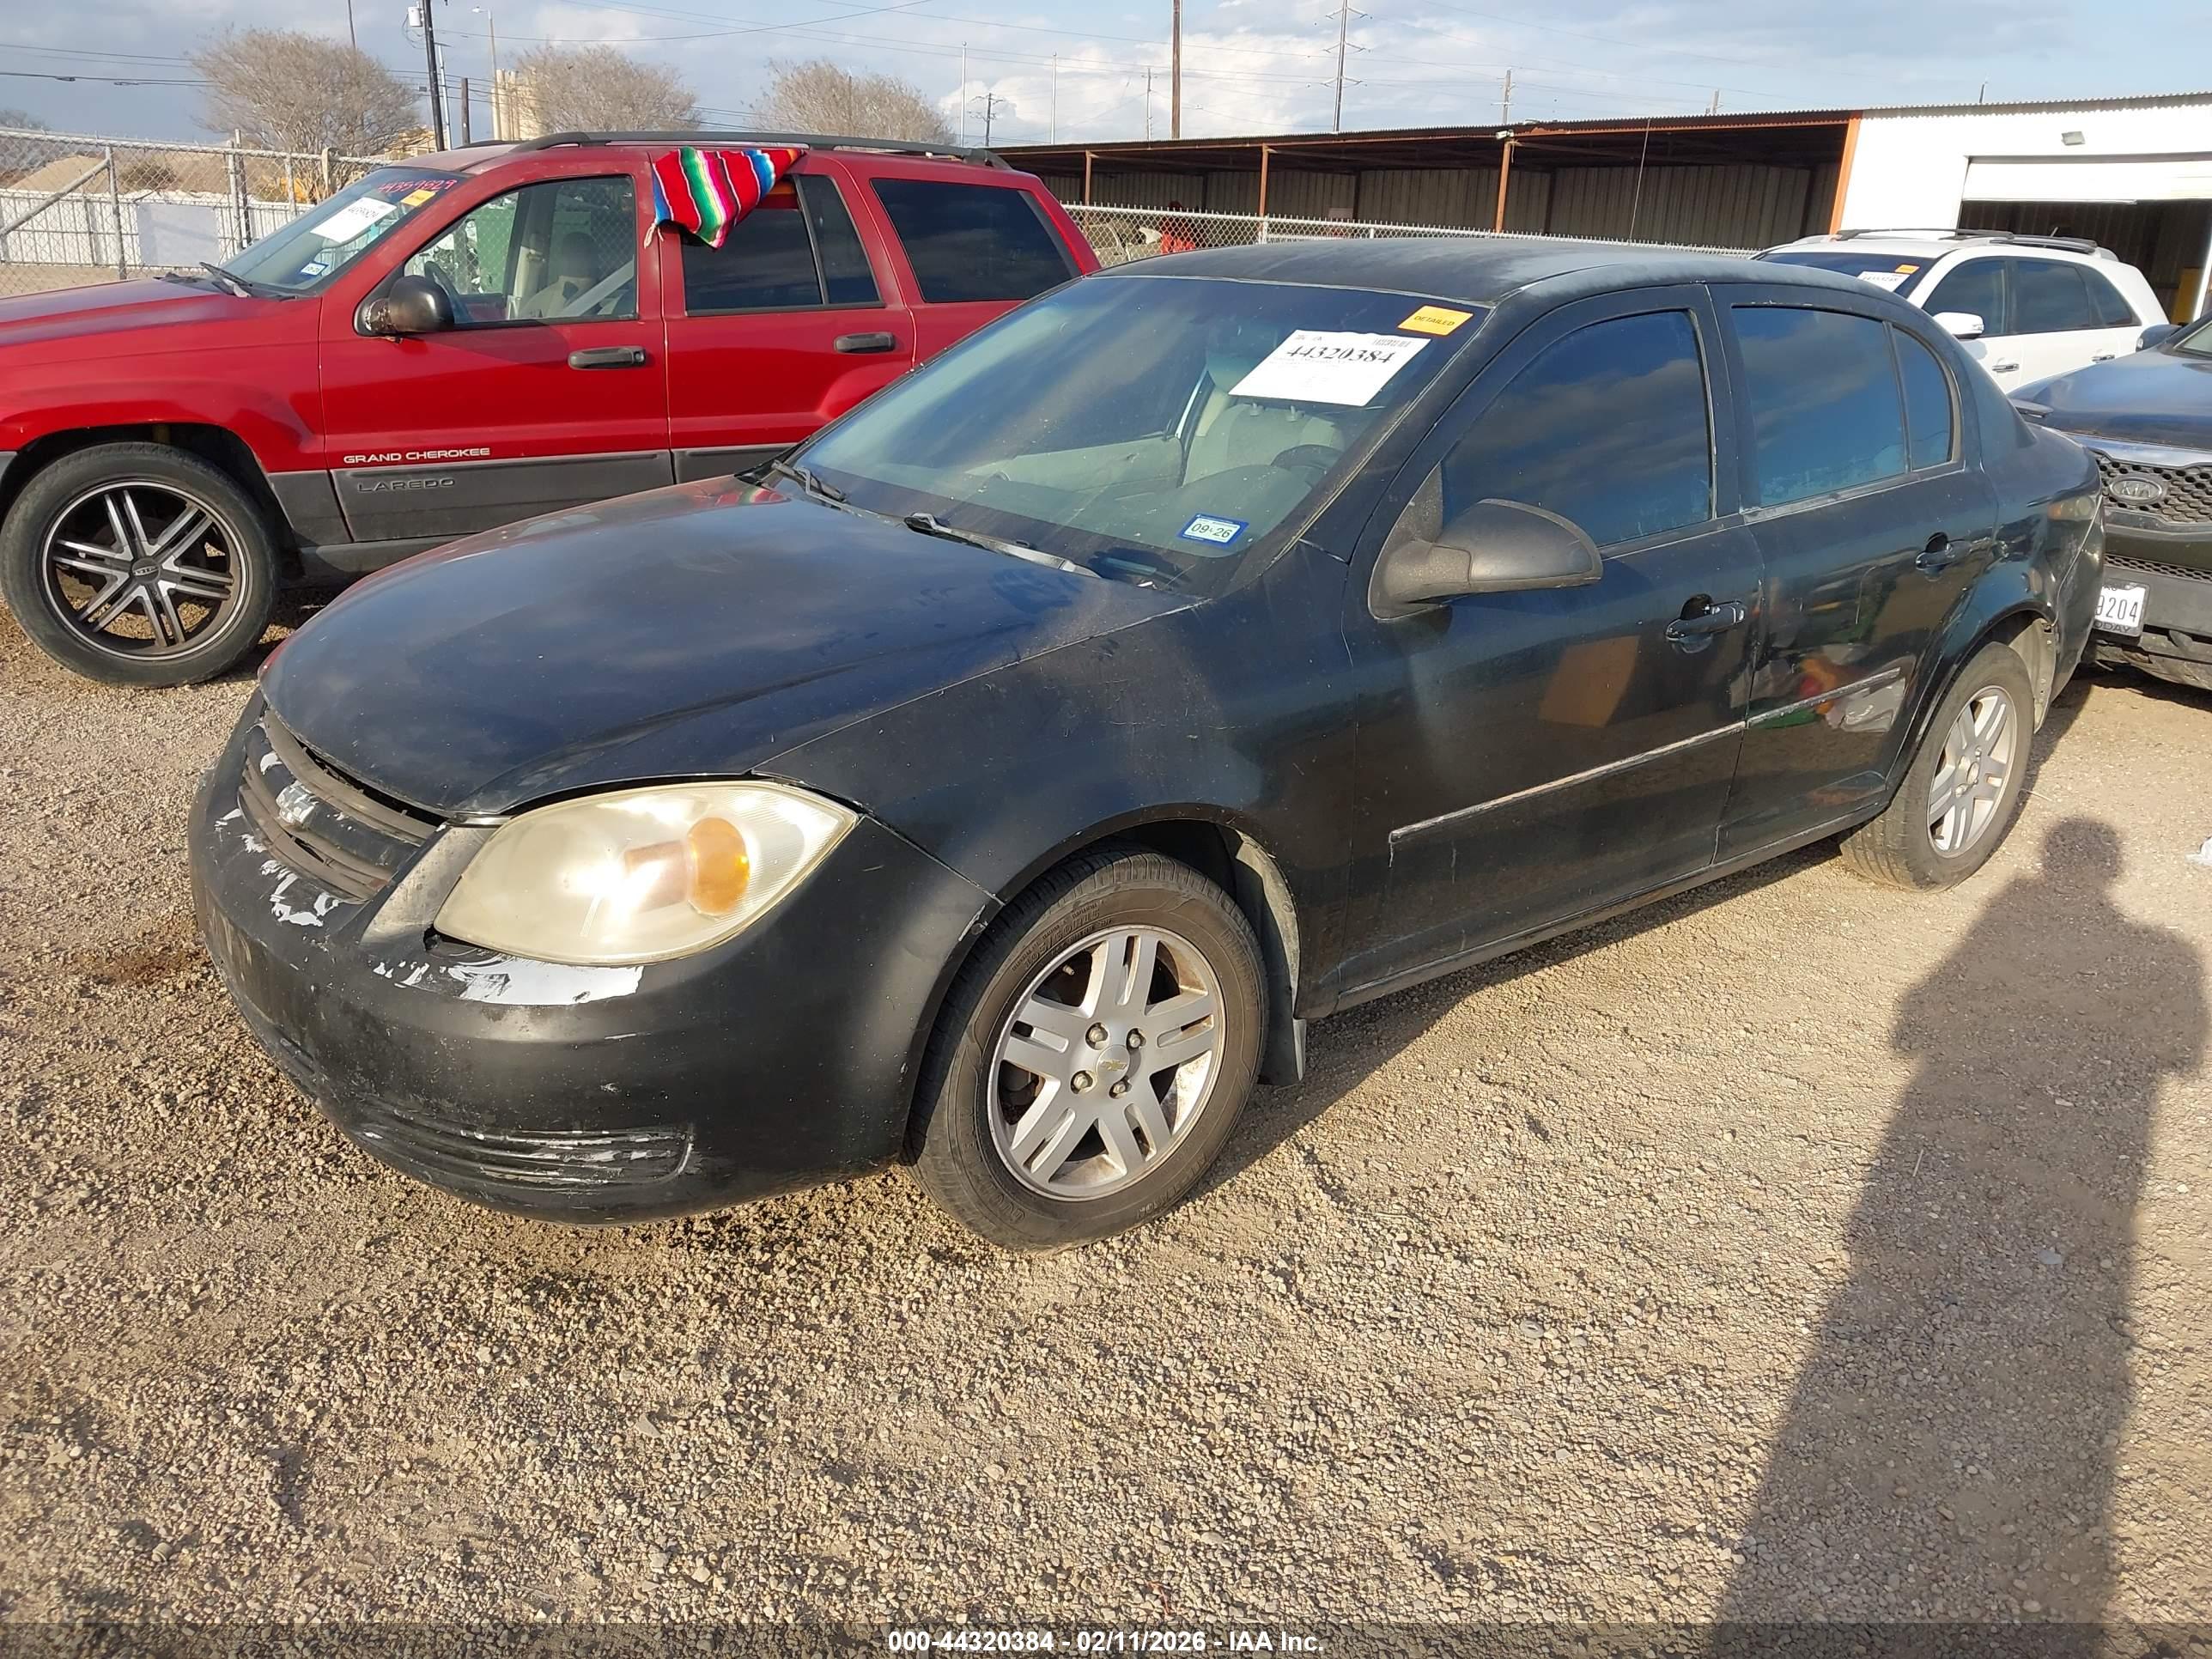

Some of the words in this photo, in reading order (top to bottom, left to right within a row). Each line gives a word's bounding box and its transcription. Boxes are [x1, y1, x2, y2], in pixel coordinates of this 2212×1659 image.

[1413, 315, 1455, 326] DETAILED
[1286, 345, 1395, 363] 44320384
[343, 453, 402, 464] GRAND
[405, 447, 490, 460] CHEROKEE
[357, 477, 455, 492] LAREDO
